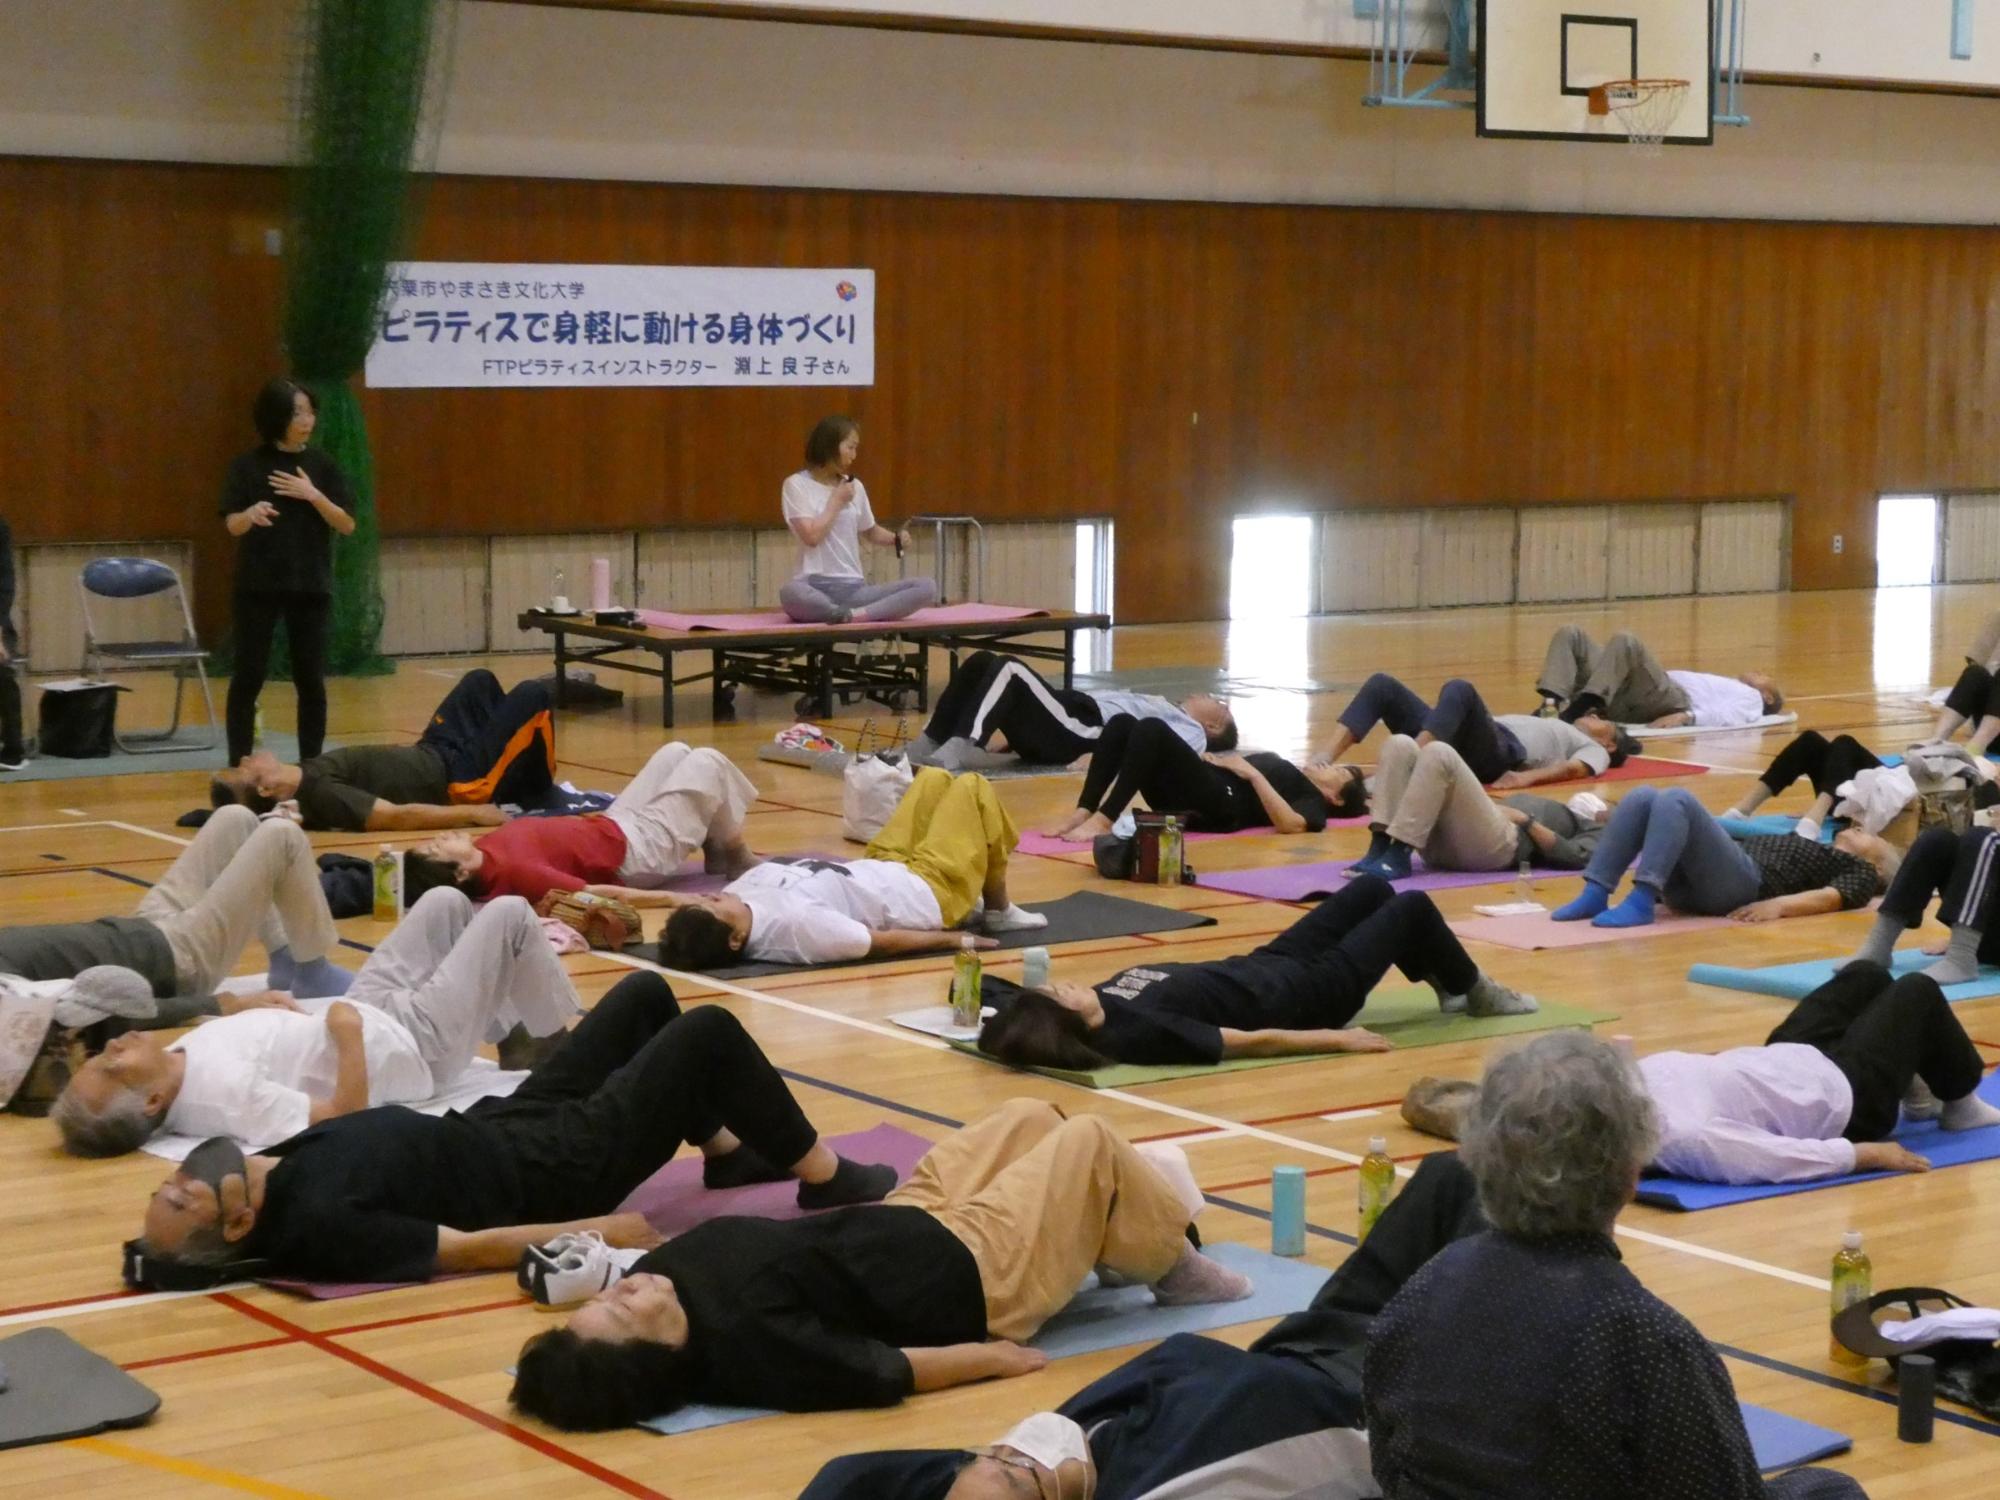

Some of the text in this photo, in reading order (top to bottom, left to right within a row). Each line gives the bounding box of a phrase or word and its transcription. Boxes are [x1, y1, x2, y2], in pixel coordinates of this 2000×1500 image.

[381, 309, 855, 345] ピラティスで身軽に動ける身体づくり
[483, 359, 717, 377] FTPピラティスインストラクター
